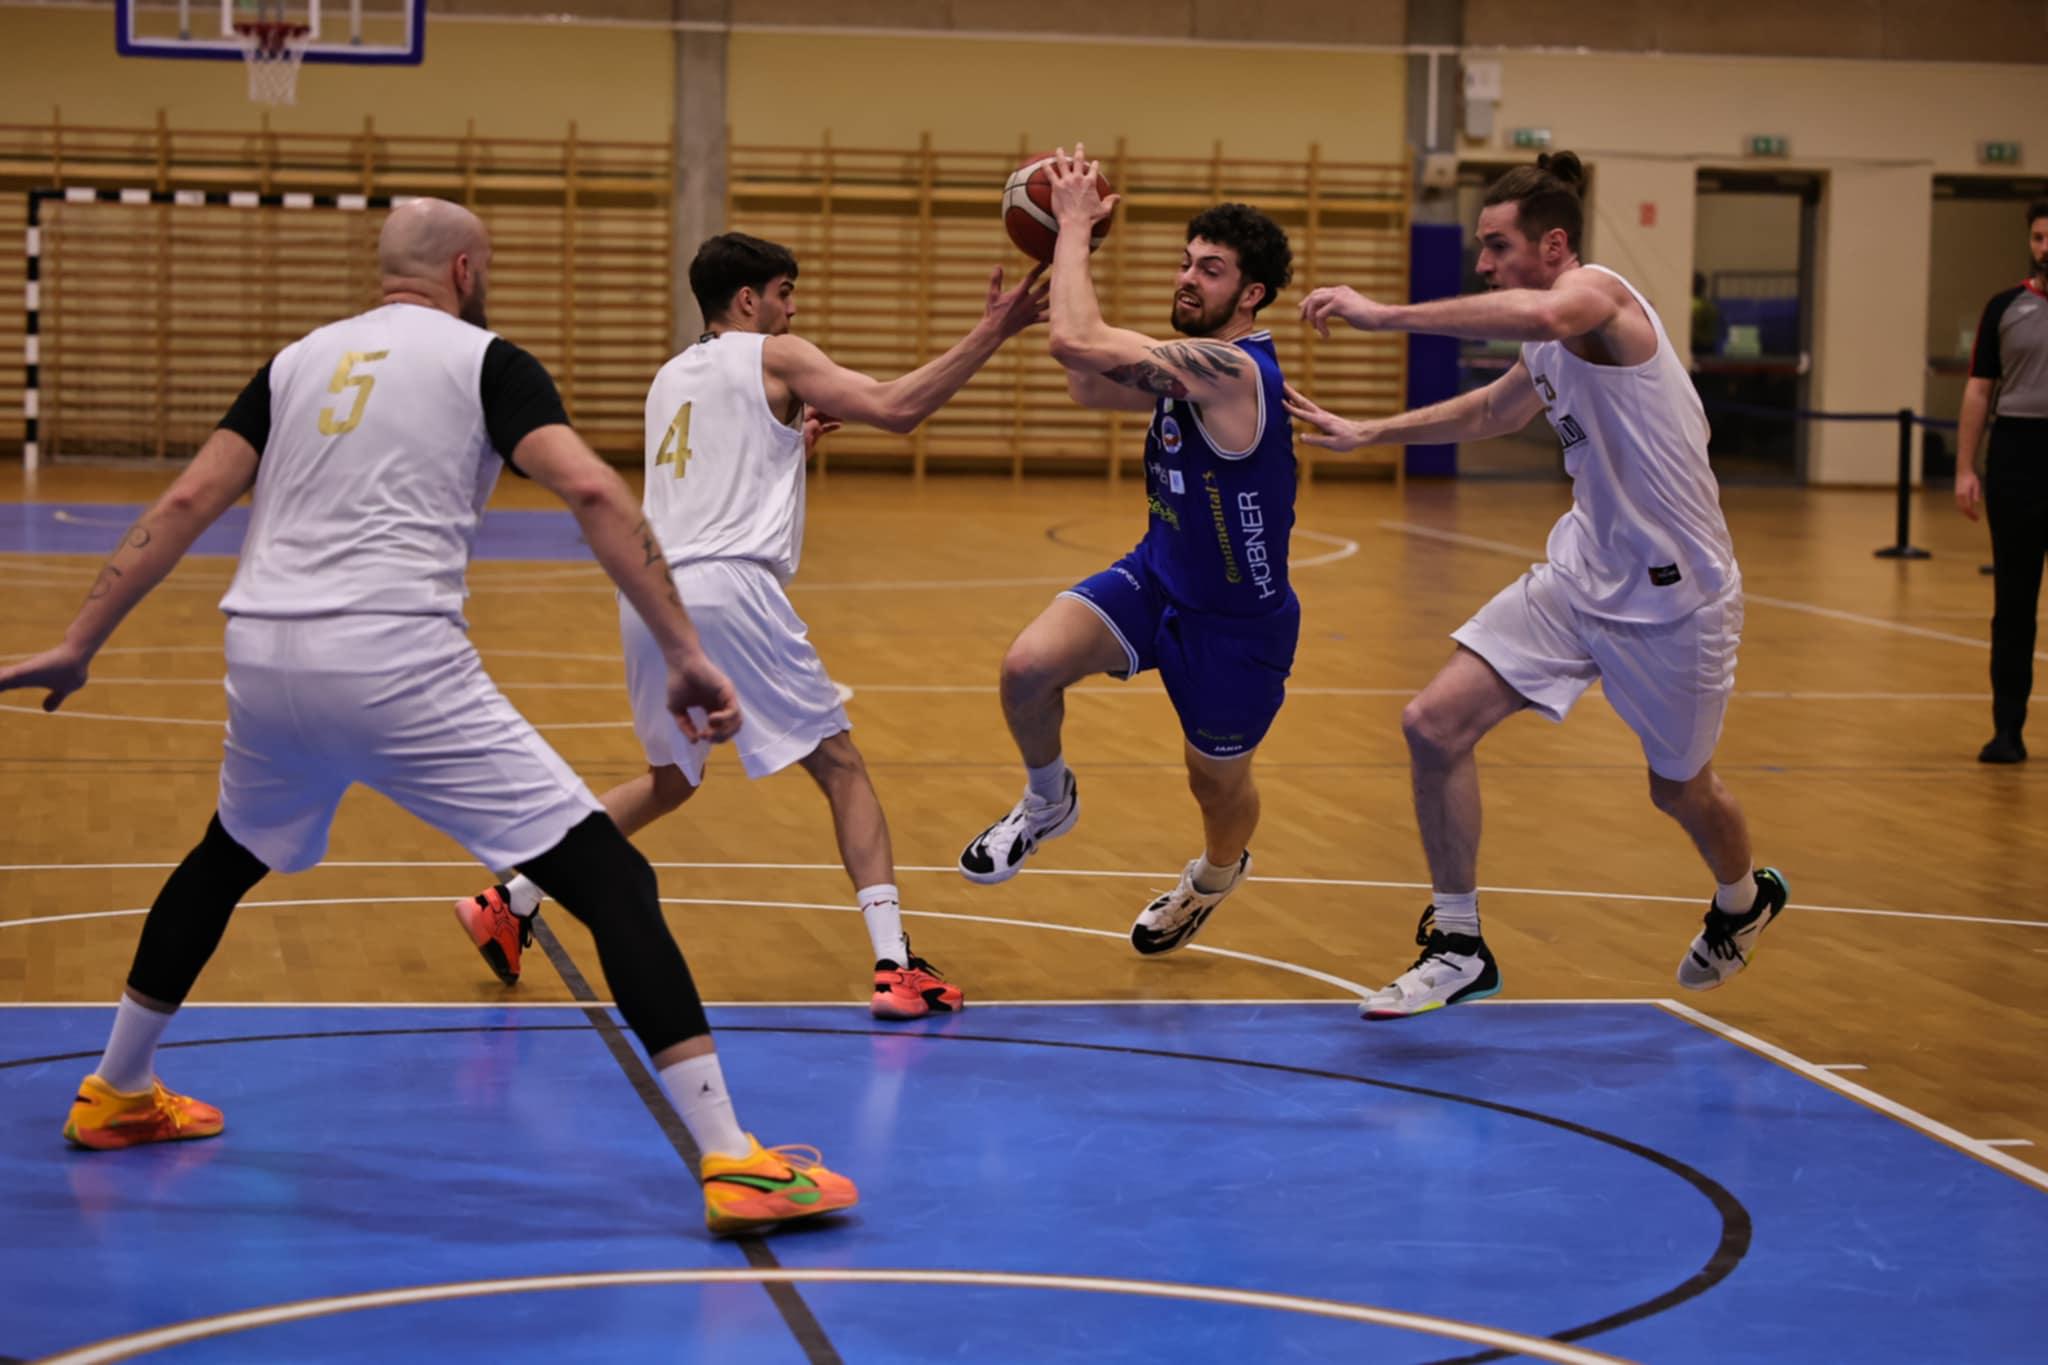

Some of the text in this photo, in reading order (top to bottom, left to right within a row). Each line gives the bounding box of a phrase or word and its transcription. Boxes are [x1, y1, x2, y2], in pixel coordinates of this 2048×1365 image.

[317, 349, 390, 437] 5
[655, 400, 693, 480] 4
[1237, 491, 1276, 600] HÜBNER
